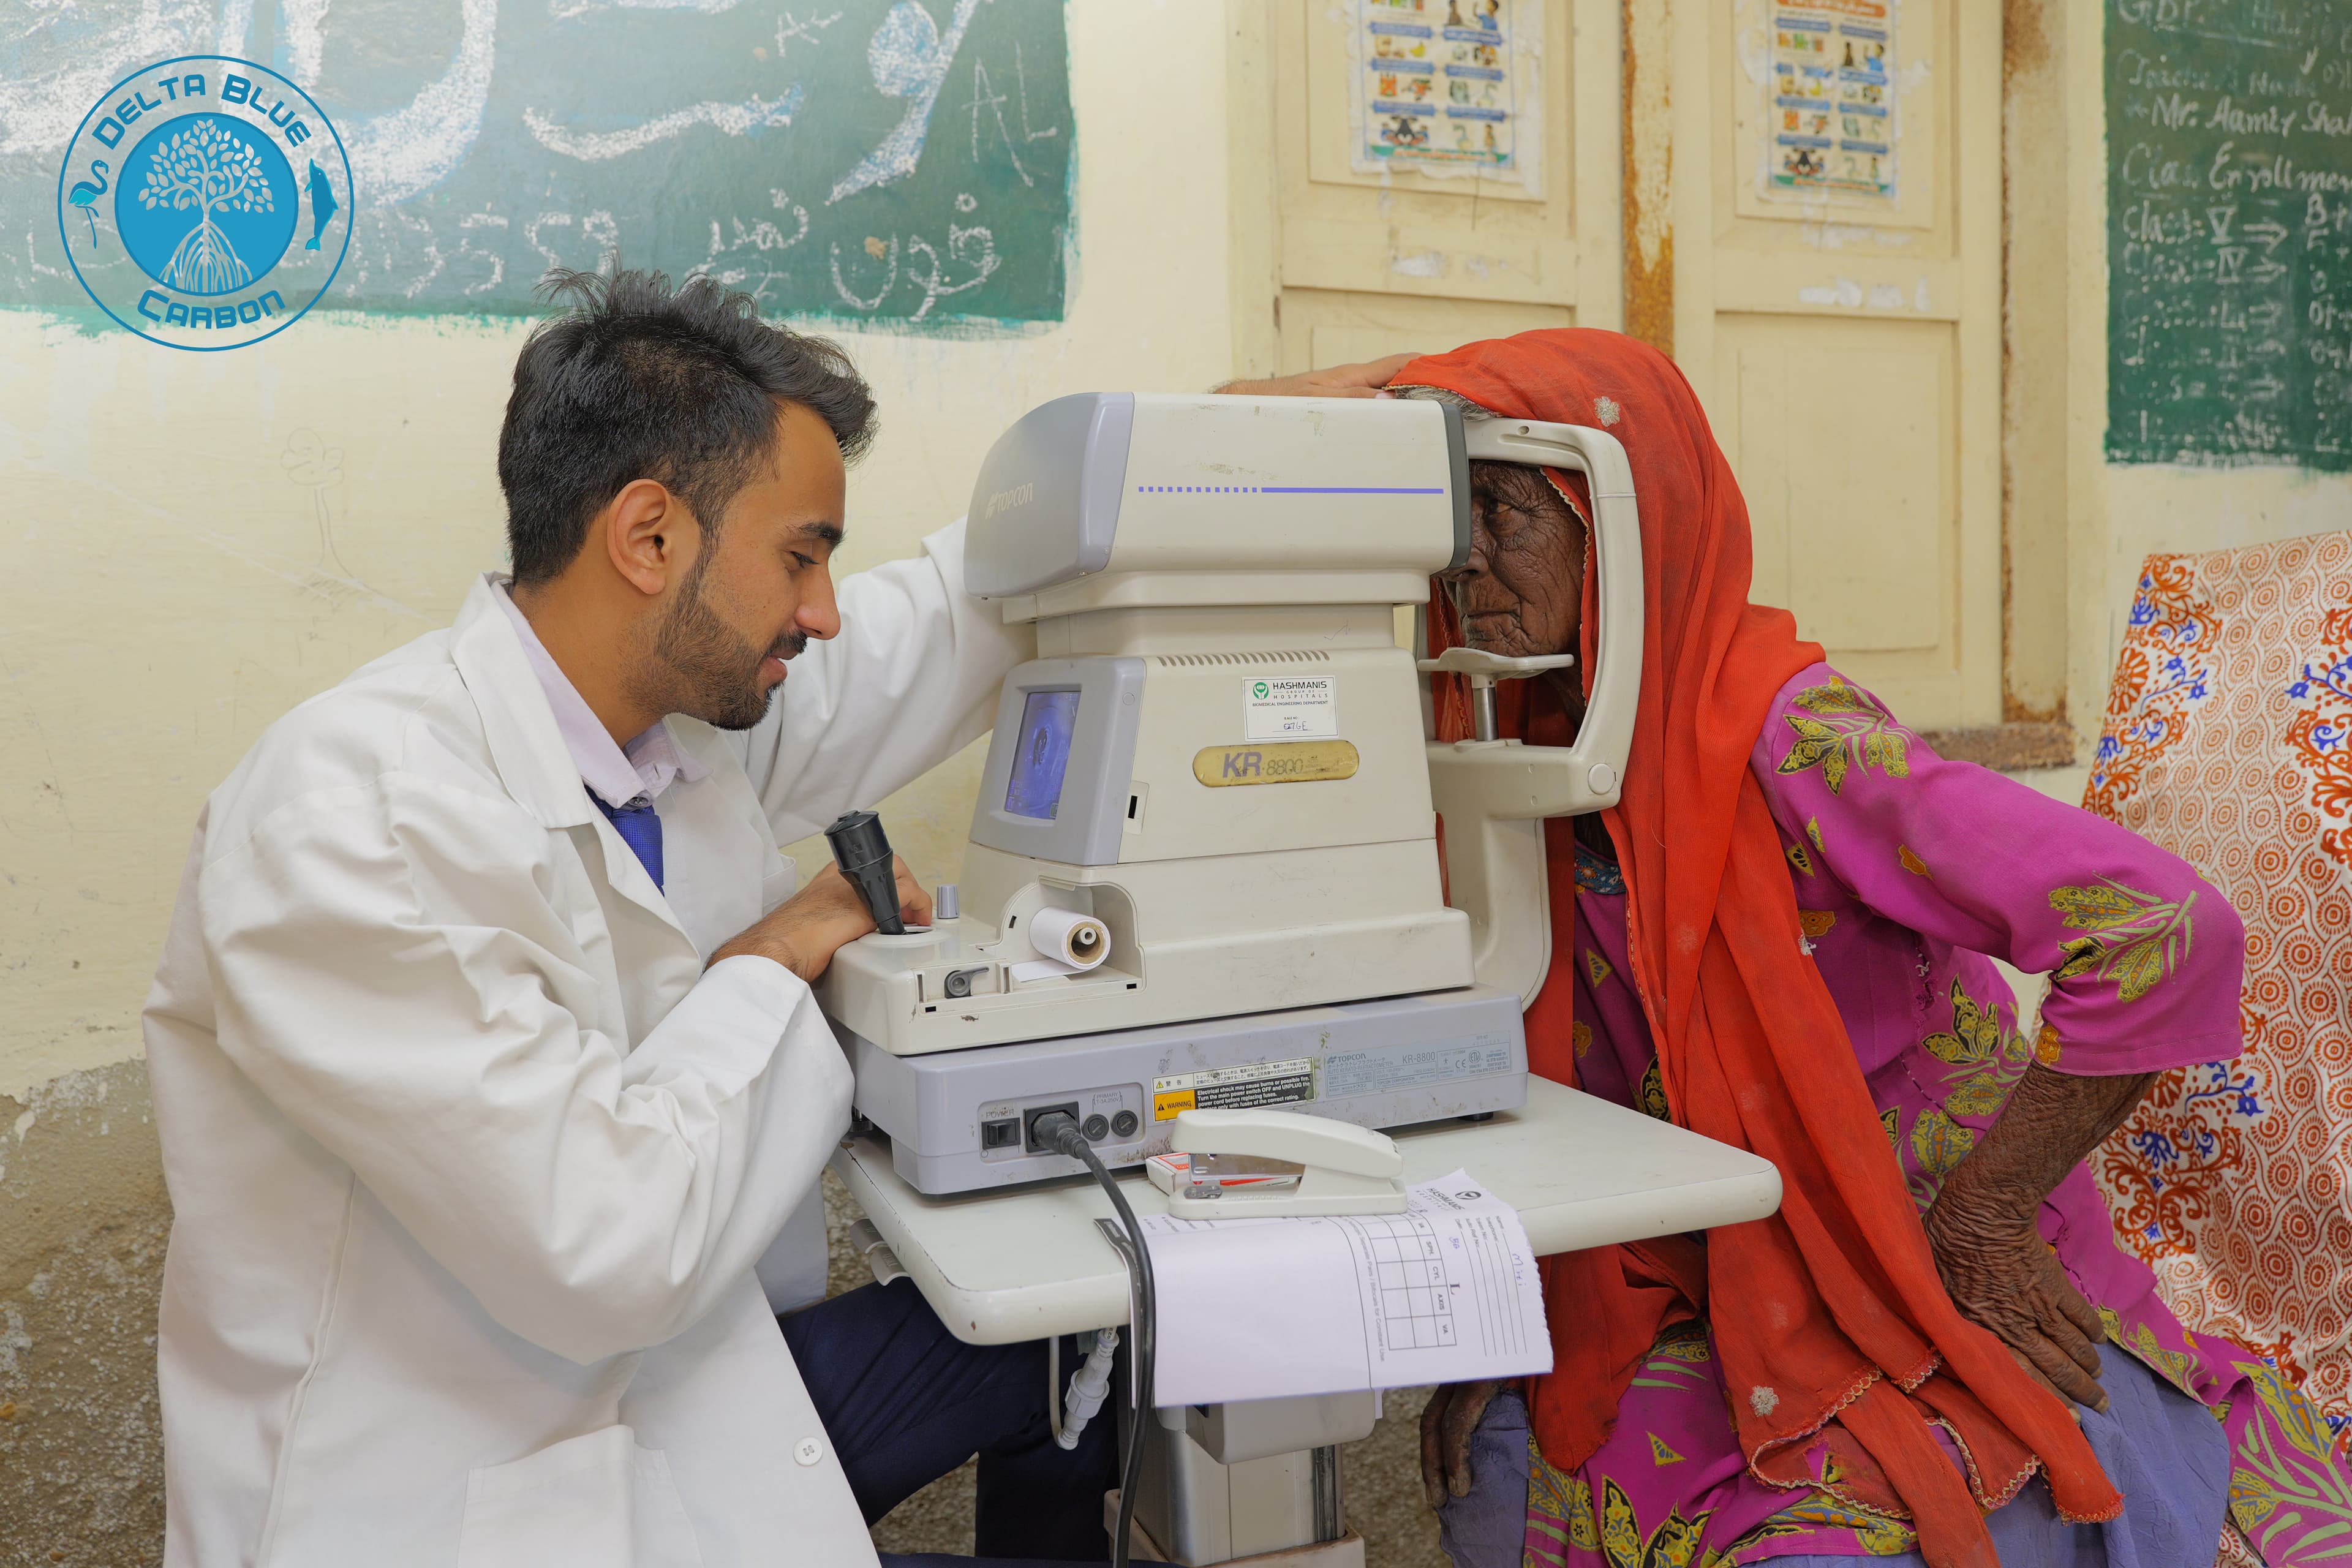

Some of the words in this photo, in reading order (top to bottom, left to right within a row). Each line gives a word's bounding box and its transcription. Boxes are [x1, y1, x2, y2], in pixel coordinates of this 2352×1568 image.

[1273, 680, 1327, 690] HASHMANIS
[1223, 751, 1262, 778] KR
[1337, 1053, 1366, 1063] TOPCON
[1402, 1051, 1436, 1064] KR-8800
[1166, 1100, 1192, 1109] WARNING
[986, 1108, 1014, 1119] POWER
[1449, 1281, 1460, 1295] L
[1437, 1293, 1446, 1311] AXIS
[1442, 1324, 1449, 1335] VA
